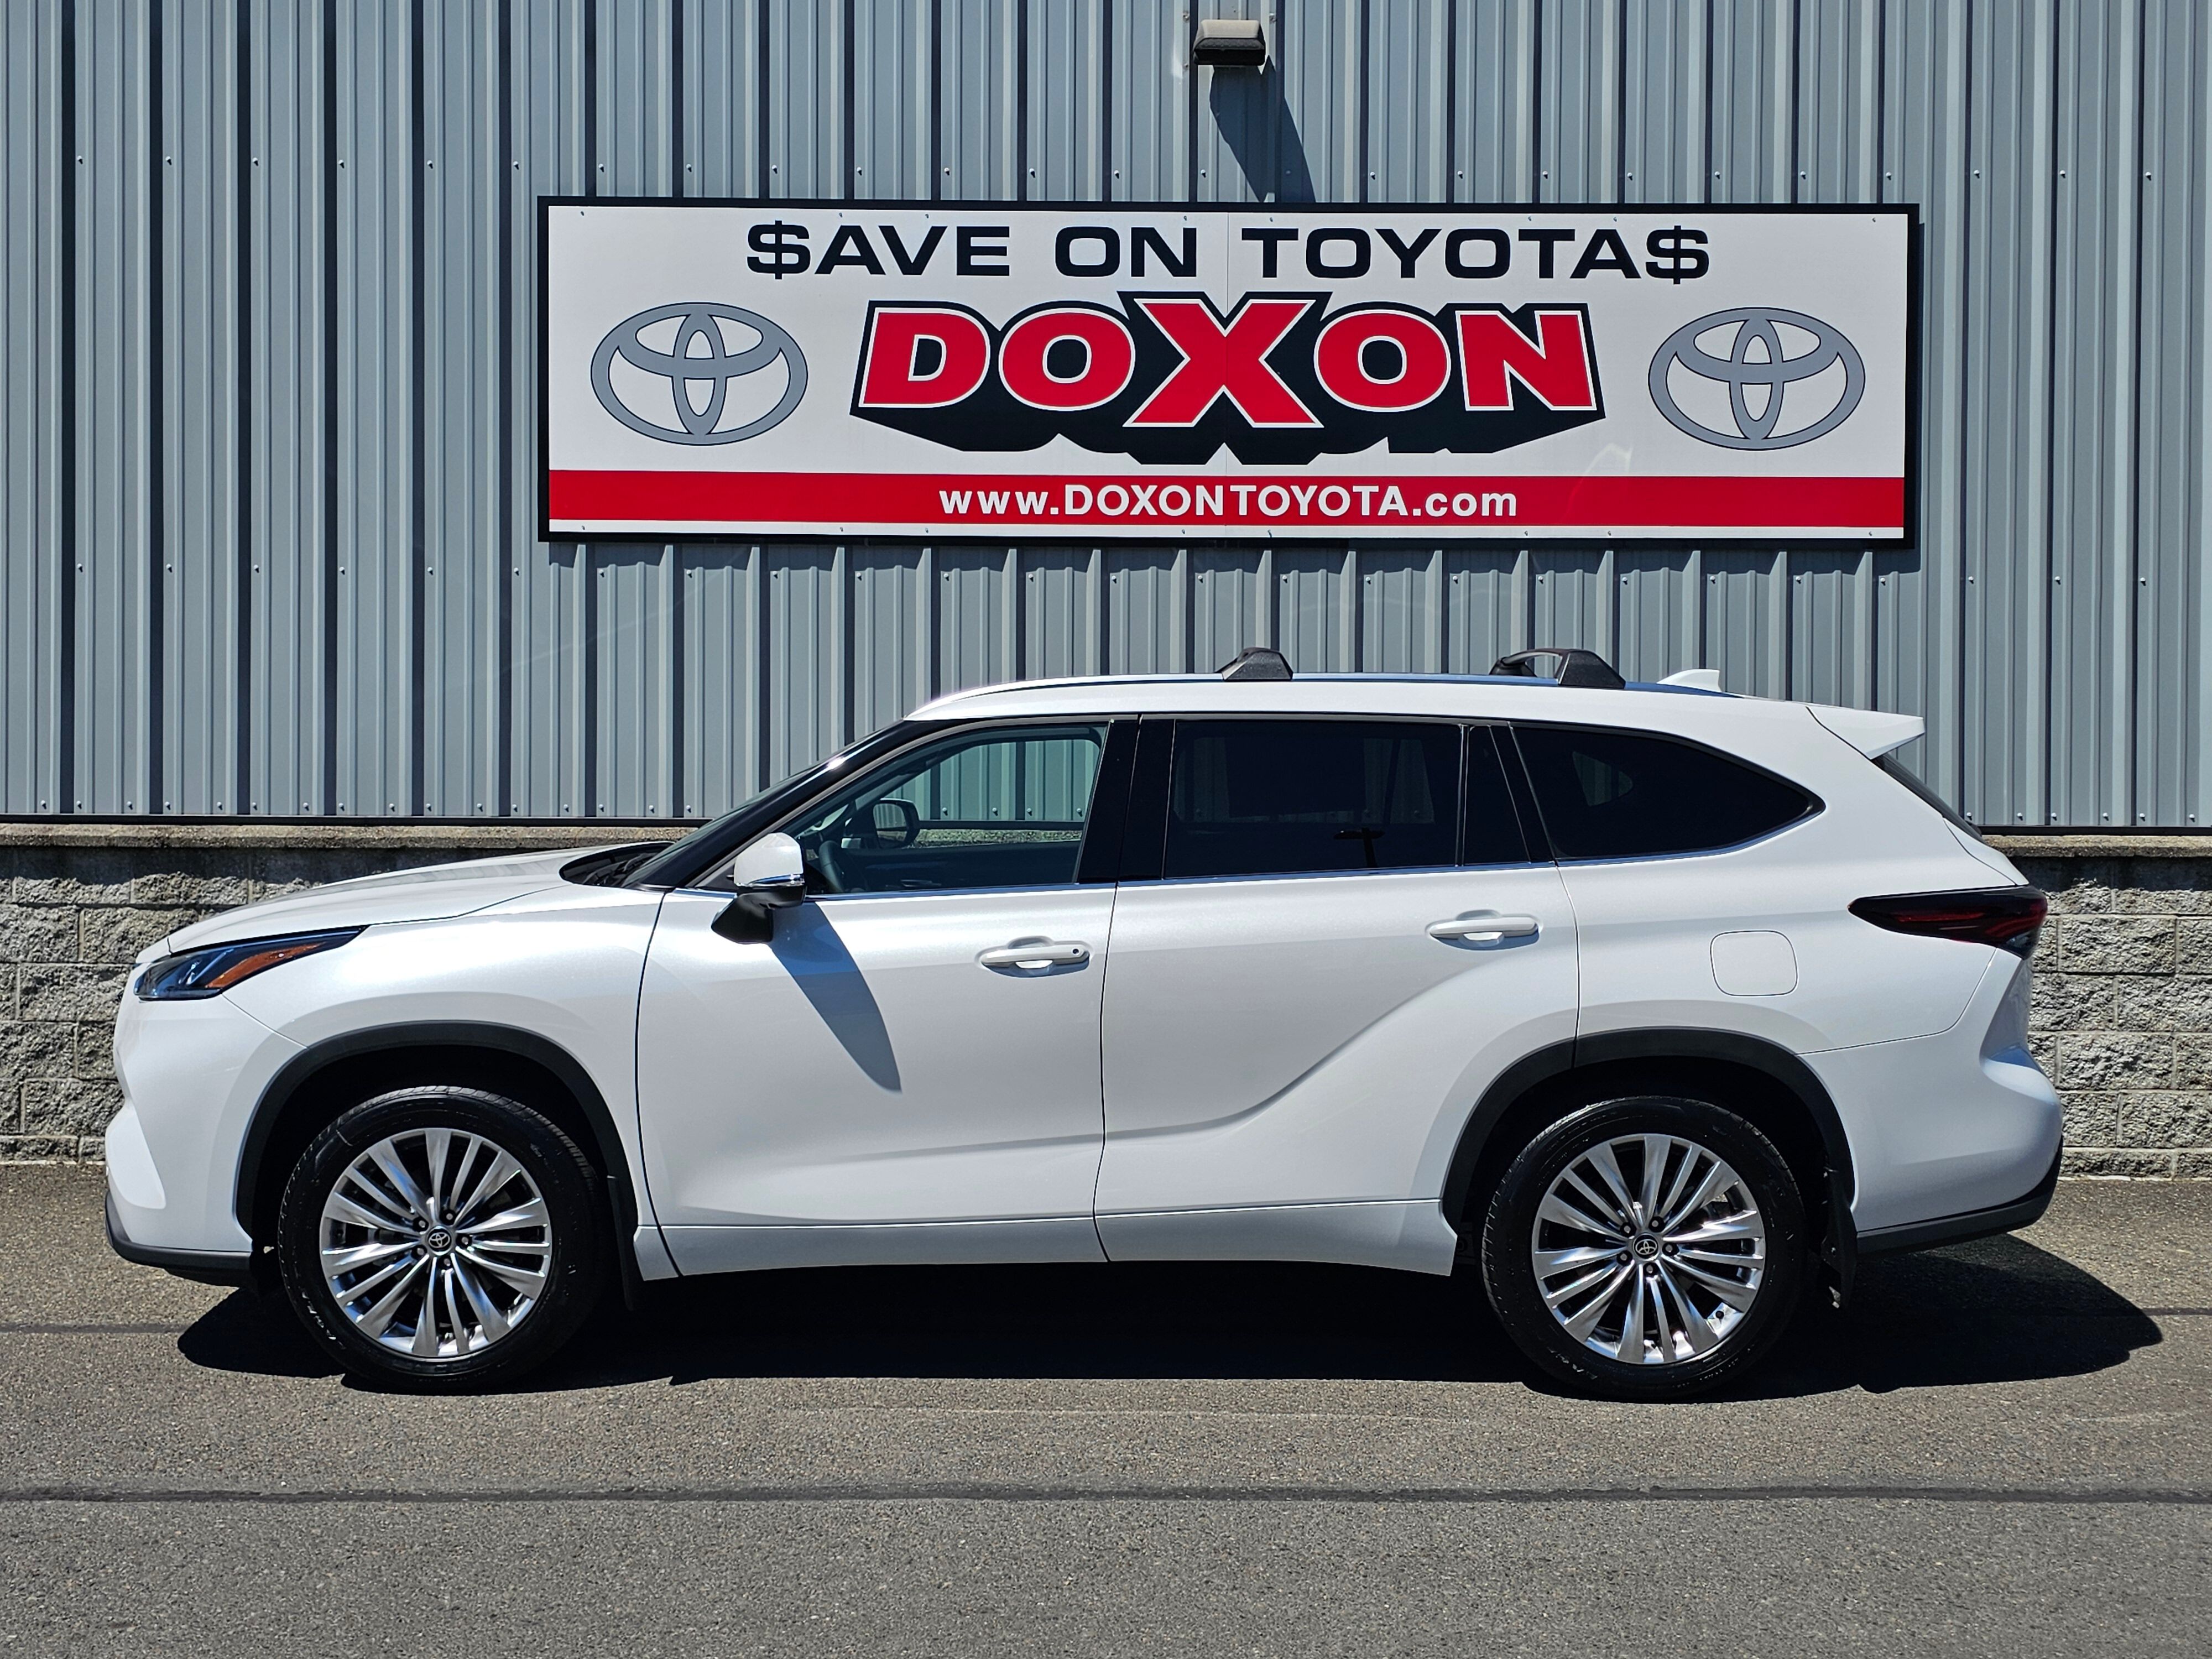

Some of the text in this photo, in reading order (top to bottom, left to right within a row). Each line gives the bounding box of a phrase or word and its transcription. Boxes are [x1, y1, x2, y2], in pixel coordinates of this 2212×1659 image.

[747, 220, 1709, 285] $AVE ON TOYOTA$
[856, 295, 1600, 431] DOXON
[939, 484, 1517, 518] www.DOXONTOYOTA.com
